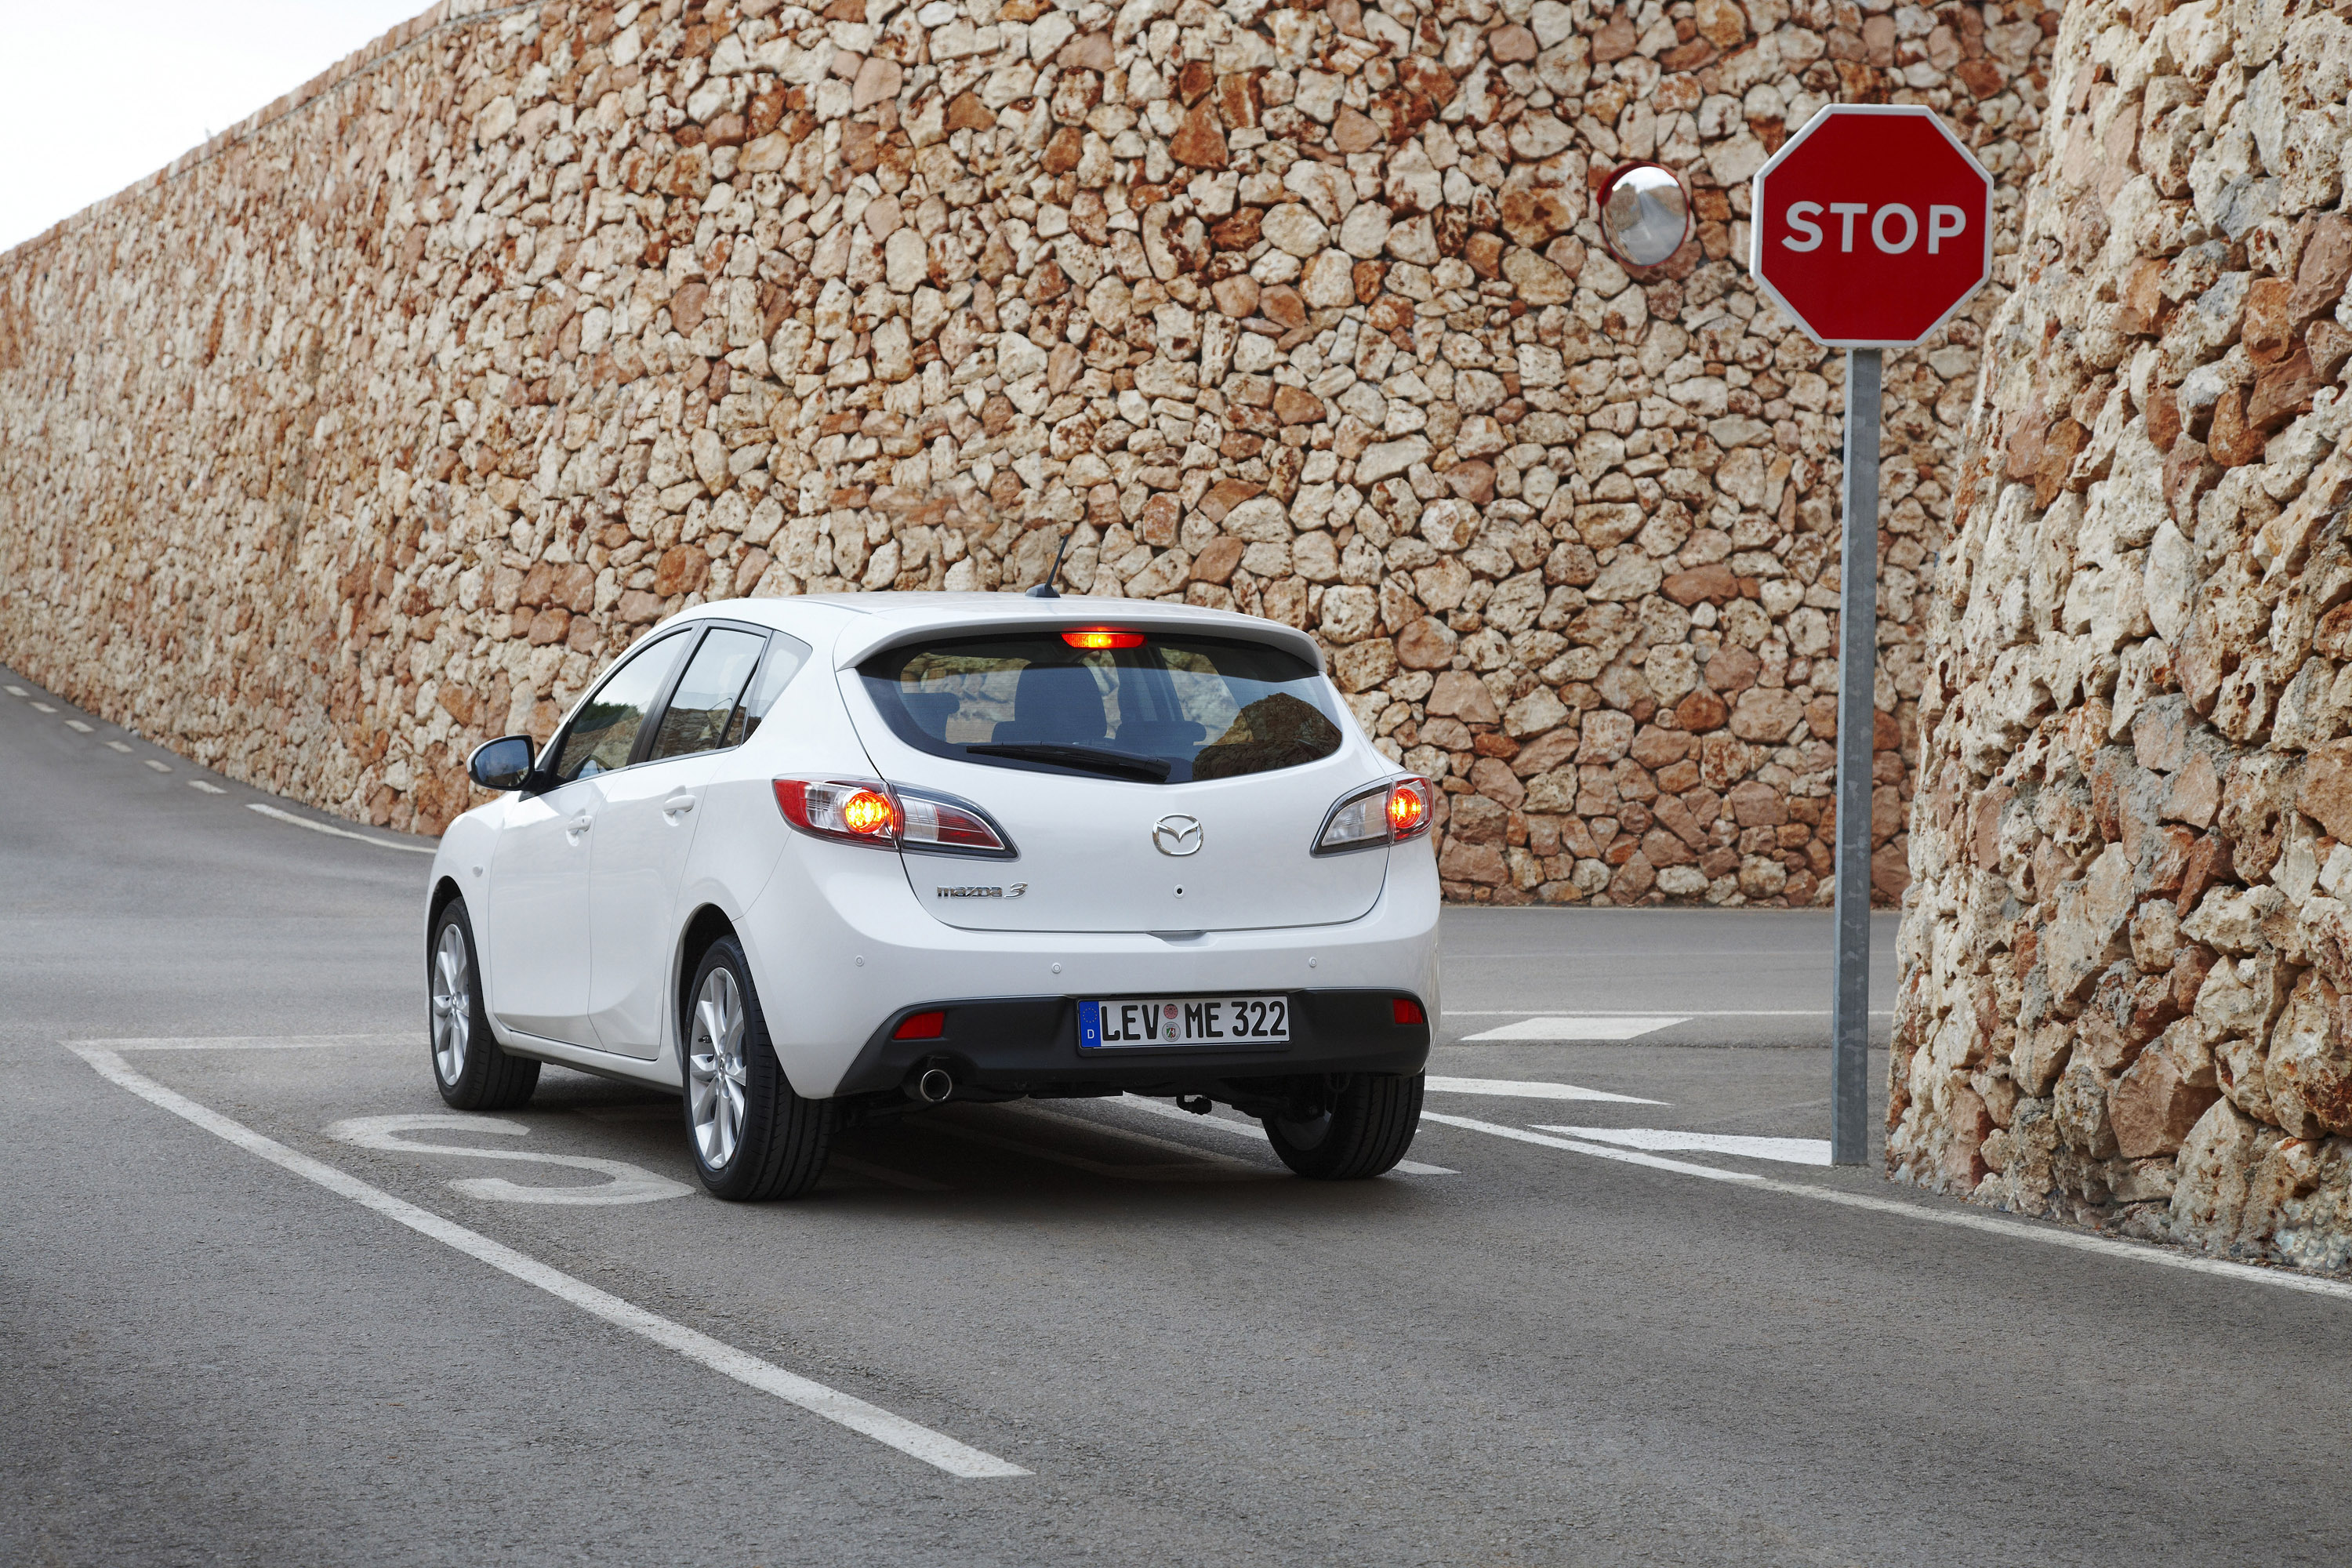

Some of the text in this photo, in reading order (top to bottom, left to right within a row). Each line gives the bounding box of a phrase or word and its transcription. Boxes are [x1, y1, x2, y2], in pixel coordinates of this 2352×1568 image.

[1781, 201, 1966, 255] STOP
[937, 881, 1029, 899] mazda 3
[1087, 1029, 1094, 1039] D
[1101, 1004, 1160, 1041] LEV
[1184, 1002, 1223, 1039] ME
[1231, 1001, 1287, 1036] 322
